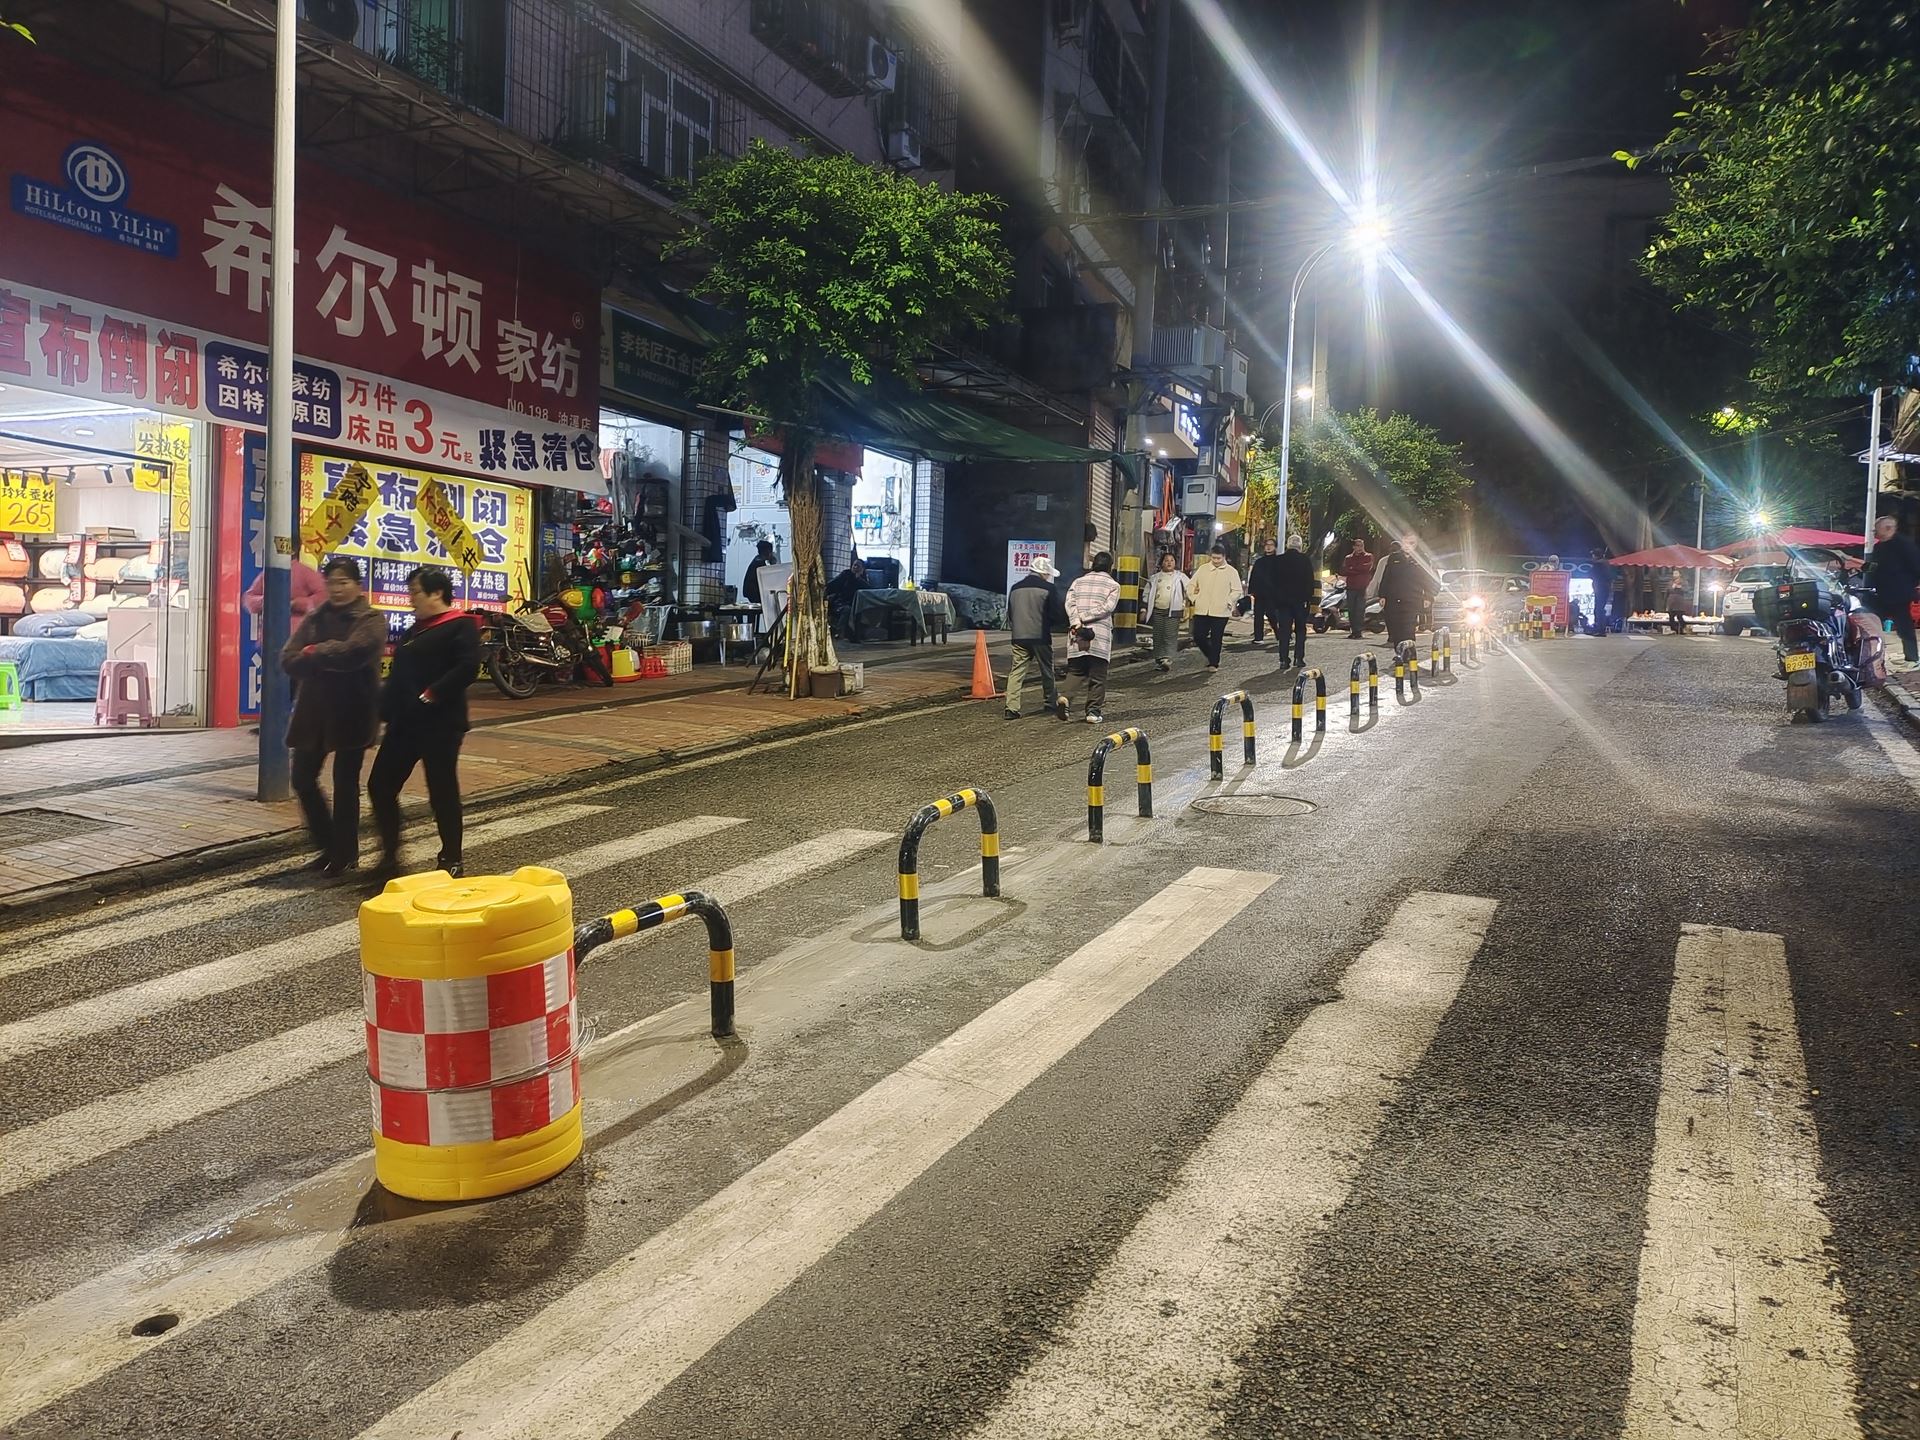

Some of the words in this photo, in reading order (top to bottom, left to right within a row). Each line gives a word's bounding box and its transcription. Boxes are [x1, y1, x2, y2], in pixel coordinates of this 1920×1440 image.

[218, 355, 331, 400] 希尔家纺
[346, 377, 397, 414] 万件
[218, 384, 331, 429] 因特原因
[479, 429, 595, 473] 紧急清仓
[8, 502, 51, 528] 265
[470, 571, 505, 592] 发热毯
